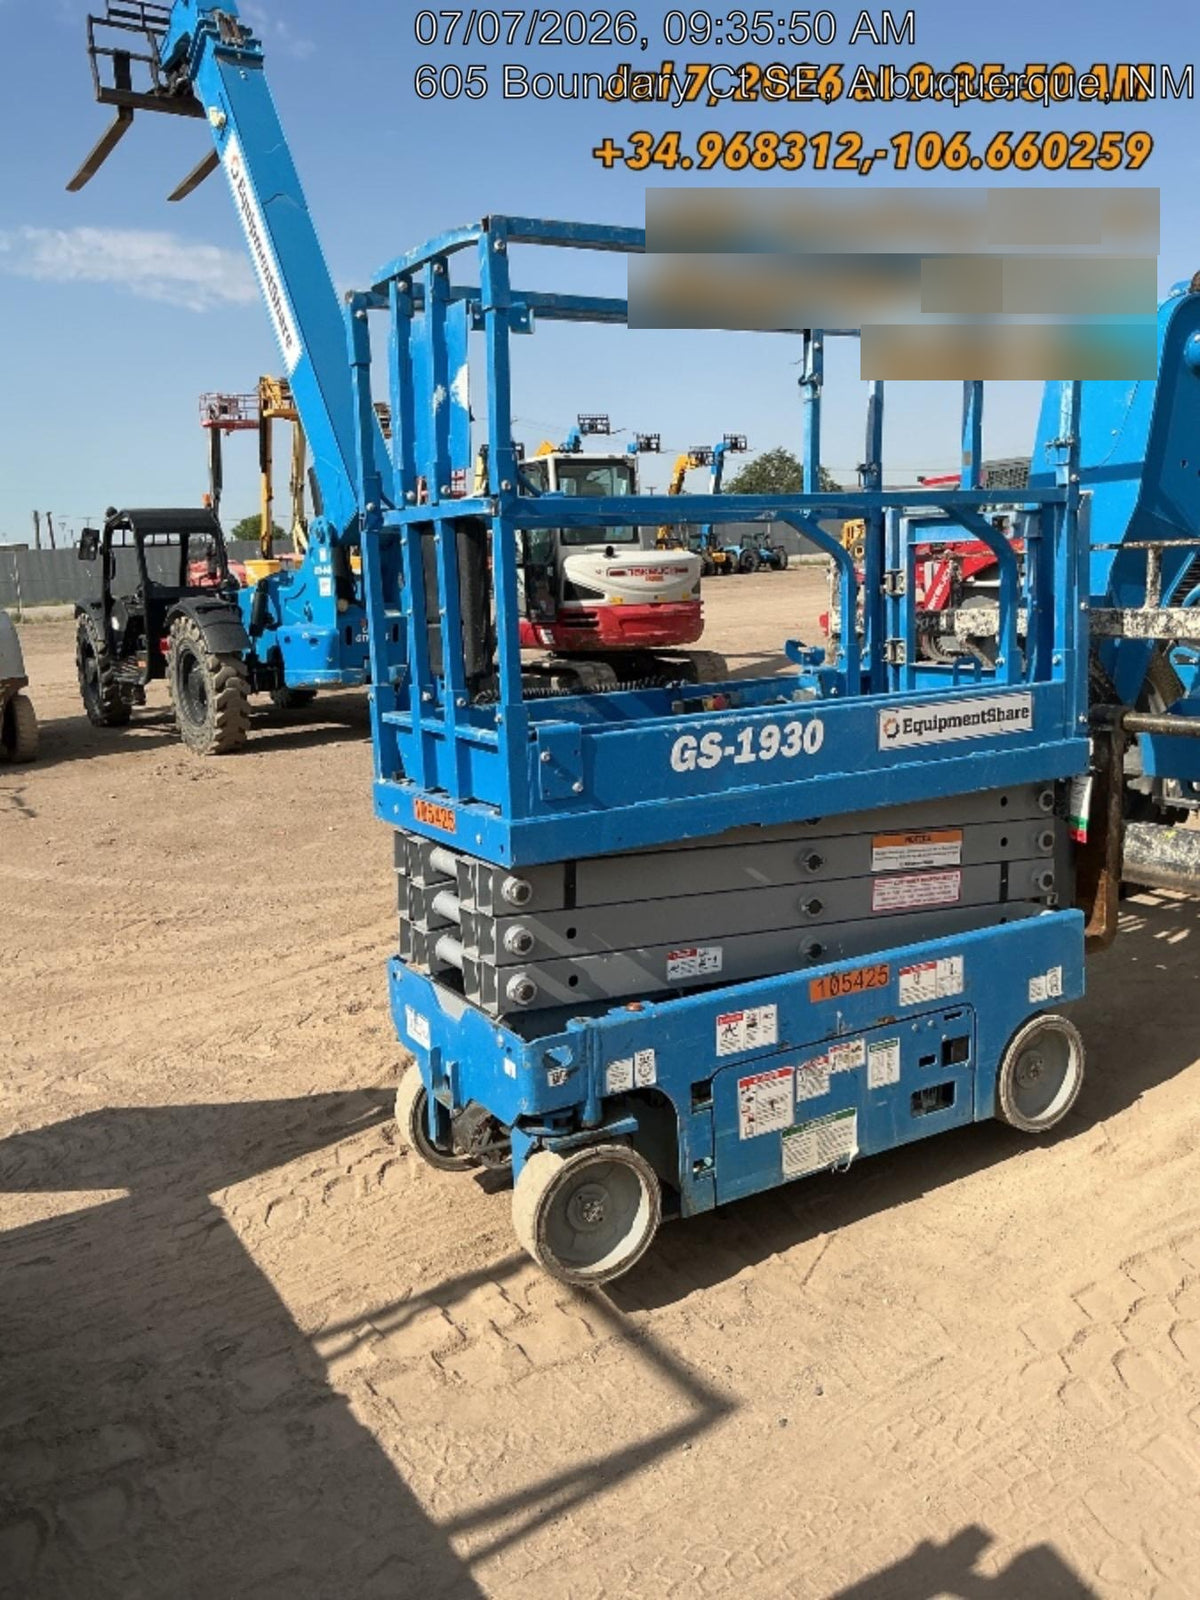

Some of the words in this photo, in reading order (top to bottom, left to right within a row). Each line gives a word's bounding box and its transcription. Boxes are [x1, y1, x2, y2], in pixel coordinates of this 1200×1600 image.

[902, 704, 1031, 736] EquipmentShare
[669, 717, 825, 773] GS-1930
[817, 964, 888, 997] 105425
